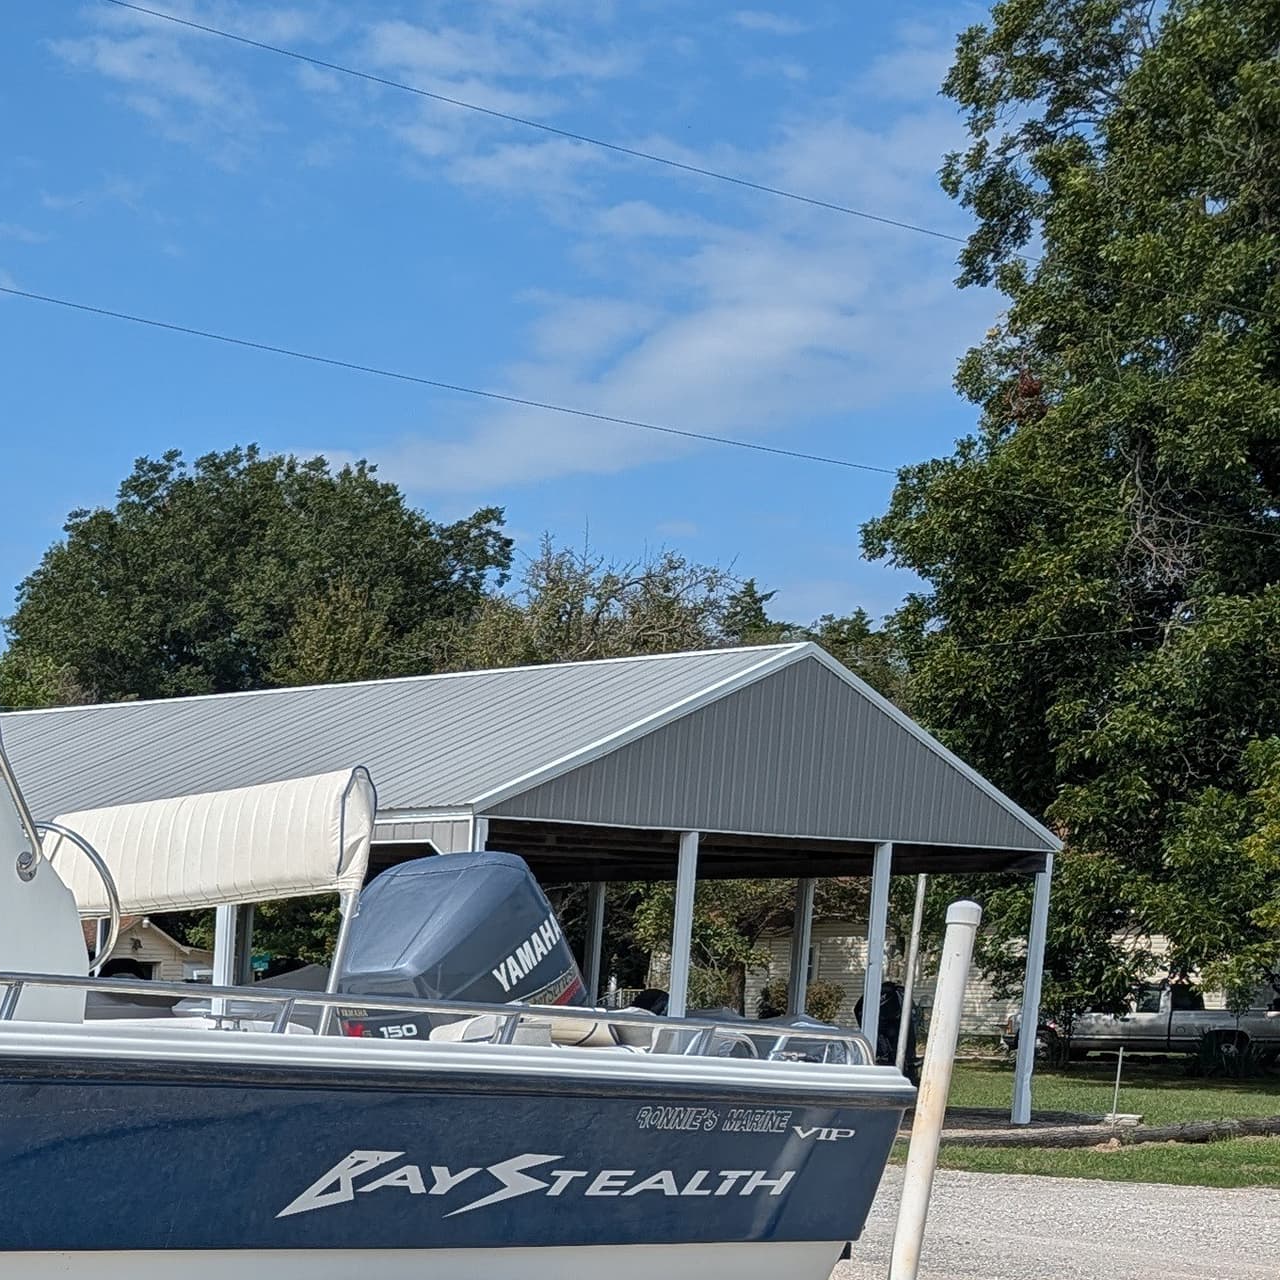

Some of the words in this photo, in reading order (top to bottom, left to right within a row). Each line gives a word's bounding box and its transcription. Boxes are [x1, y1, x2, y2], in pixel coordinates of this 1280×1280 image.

[492, 911, 564, 993] YAMAHA
[379, 1023, 418, 1039] 150
[637, 1106, 720, 1131] RONNIE'S
[722, 1109, 793, 1133] MARINE
[792, 1126, 856, 1141] VIP
